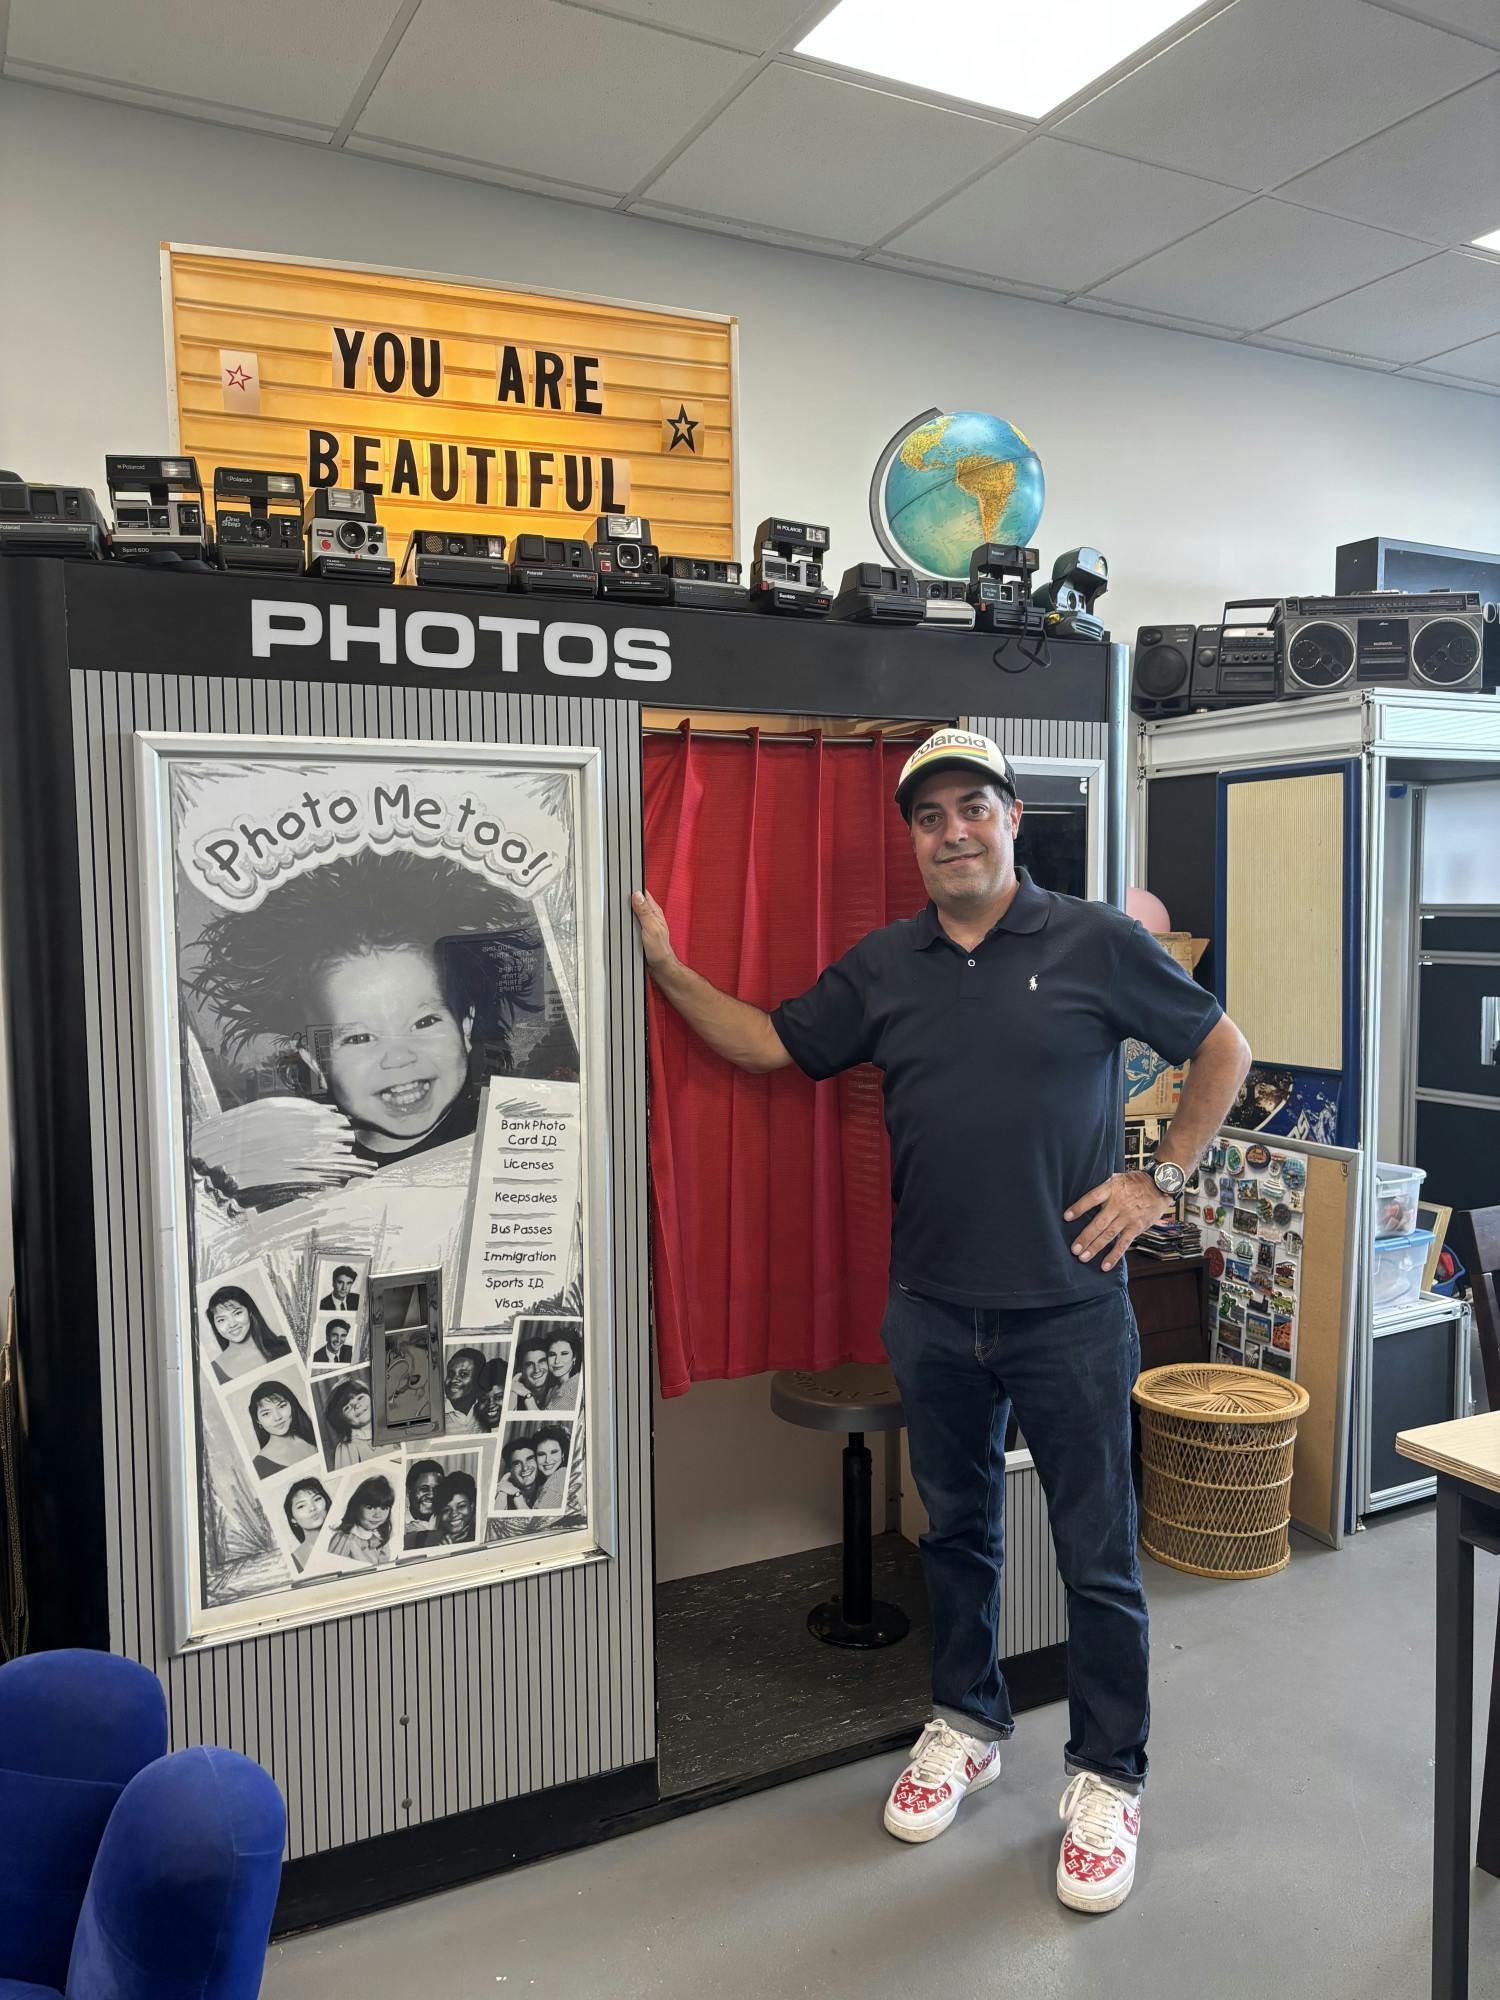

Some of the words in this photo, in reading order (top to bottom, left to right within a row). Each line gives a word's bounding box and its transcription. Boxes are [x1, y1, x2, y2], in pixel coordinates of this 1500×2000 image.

[333, 327, 442, 398] YOU
[497, 345, 603, 415] ARE
[122, 463, 146, 471] Polaroid
[308, 429, 626, 515] BEAUTIFUL
[228, 475, 253, 483] Polaroid
[781, 525, 803, 533] POLAROID
[251, 599, 672, 682] PHOTOS
[910, 734, 987, 763] Polaroid
[206, 792, 357, 881] Photo
[374, 784, 442, 830] Me
[458, 798, 548, 877] too!
[501, 1119, 530, 1131] Bank
[532, 1119, 566, 1131] Photo
[508, 1135, 538, 1146] Card
[503, 1158, 554, 1170] Licenses
[495, 1191, 558, 1204] Keepsakes
[491, 1223, 511, 1234] Bus
[513, 1223, 553, 1235] Passes
[483, 1251, 557, 1264] Immigration
[485, 1277, 524, 1290] Sports
[495, 1298, 524, 1309] Visas
